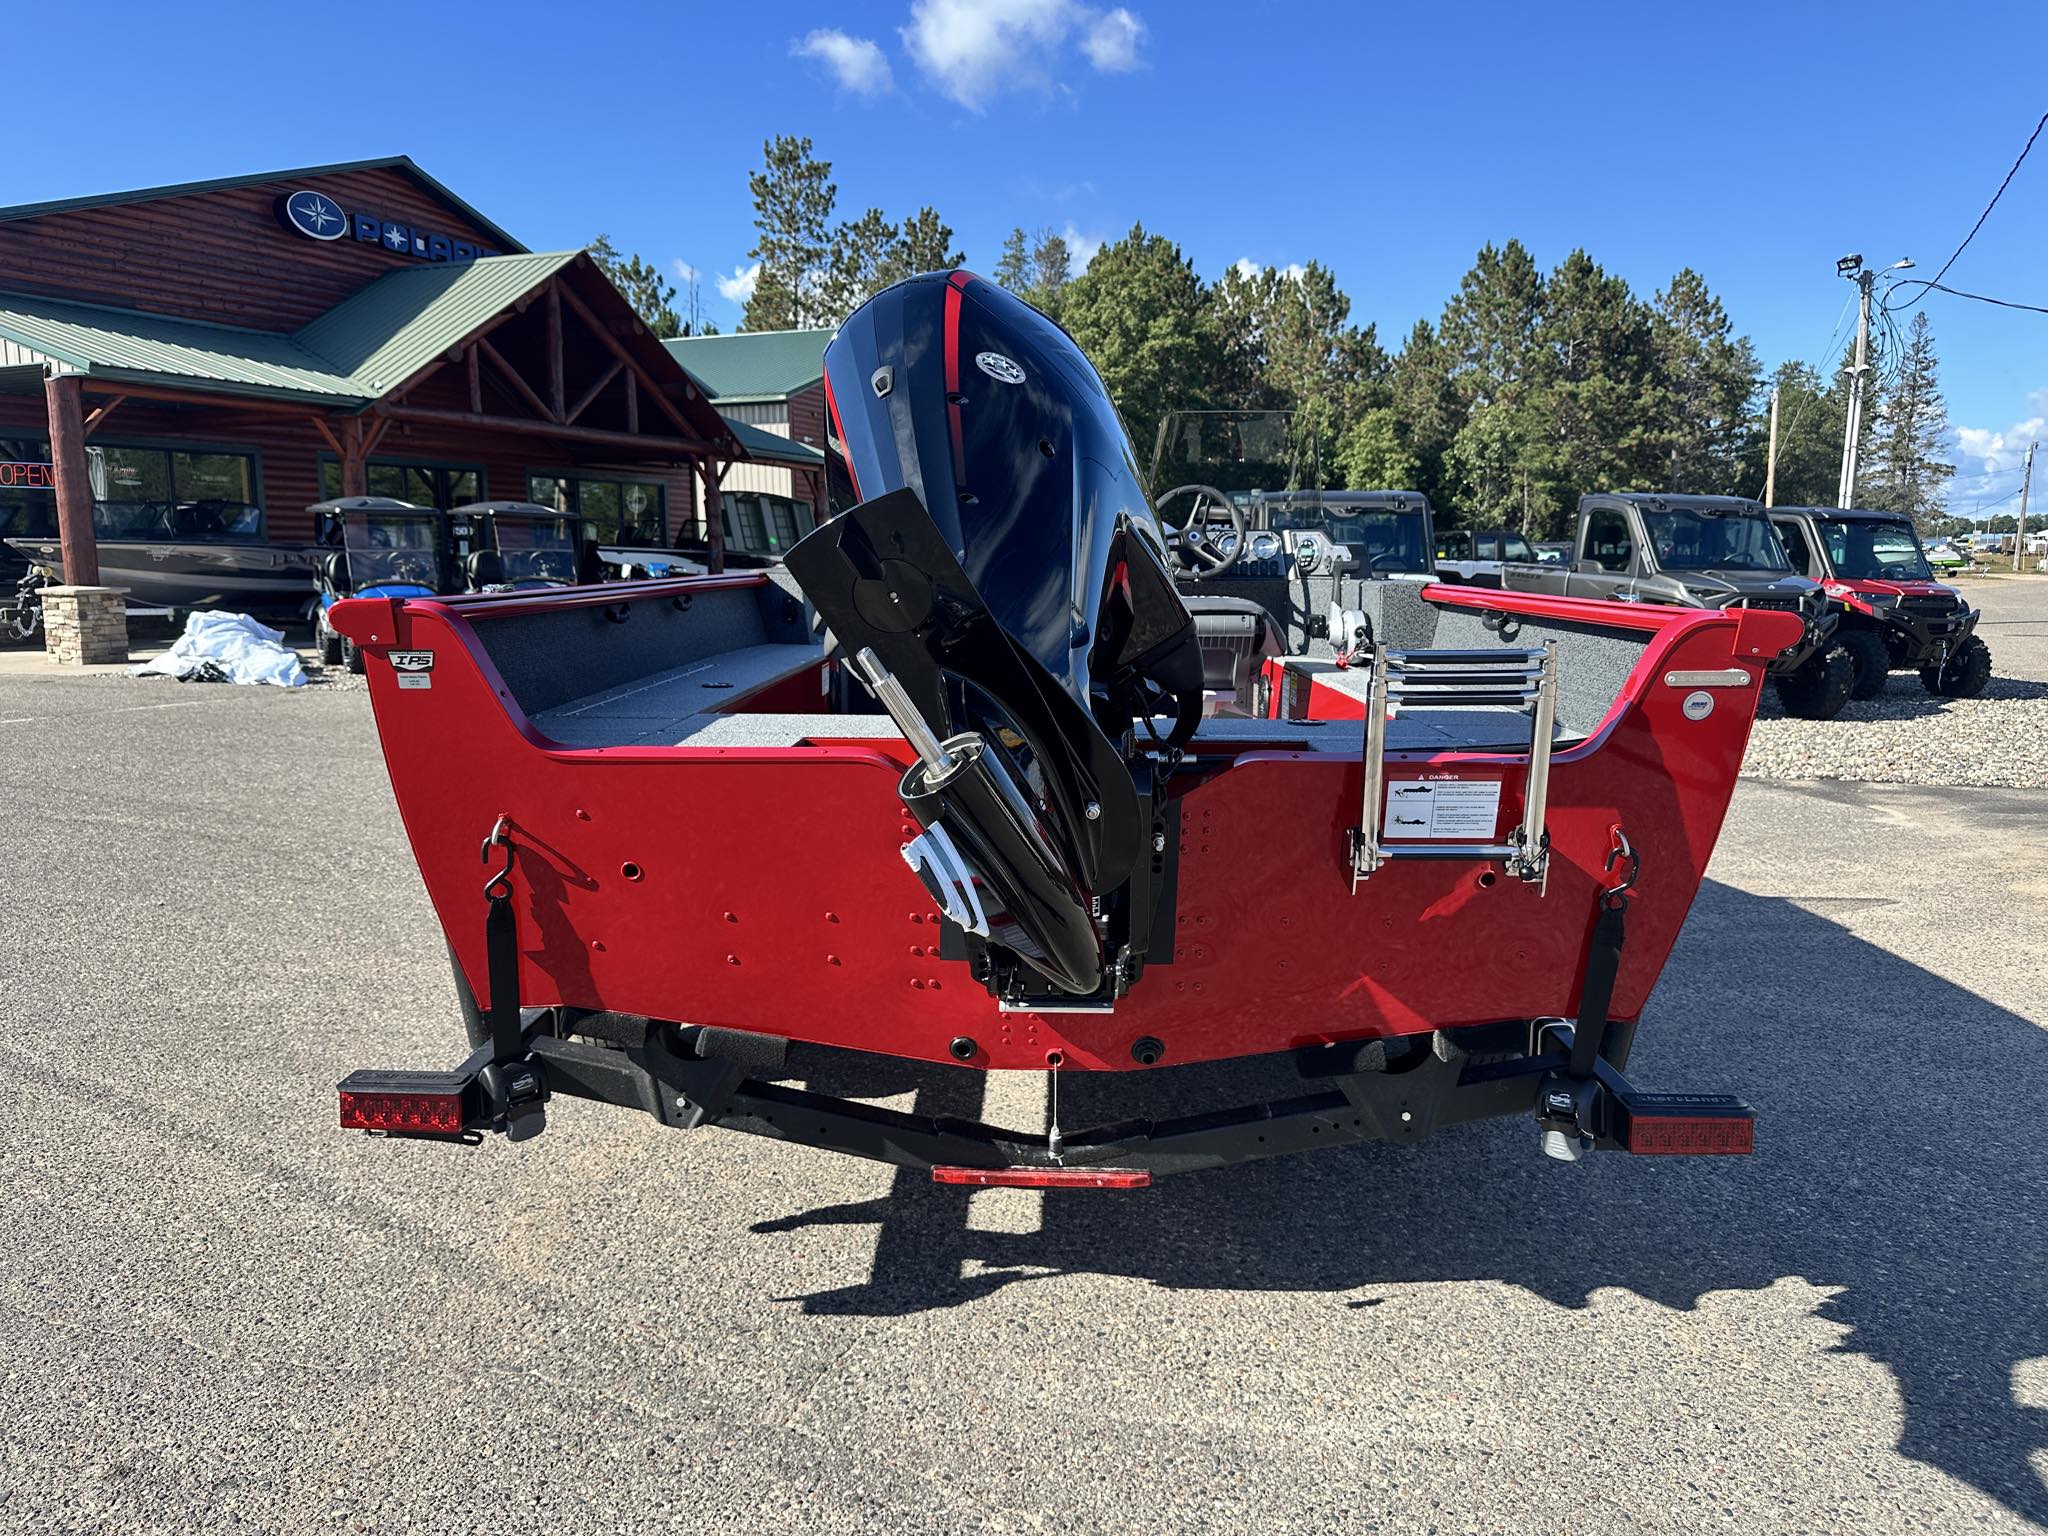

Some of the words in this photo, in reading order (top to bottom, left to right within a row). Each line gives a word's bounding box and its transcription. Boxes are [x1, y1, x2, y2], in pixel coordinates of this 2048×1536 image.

[354, 213, 503, 262] POLAR
[0, 464, 55, 486] OPEN
[395, 655, 432, 665] IPS
